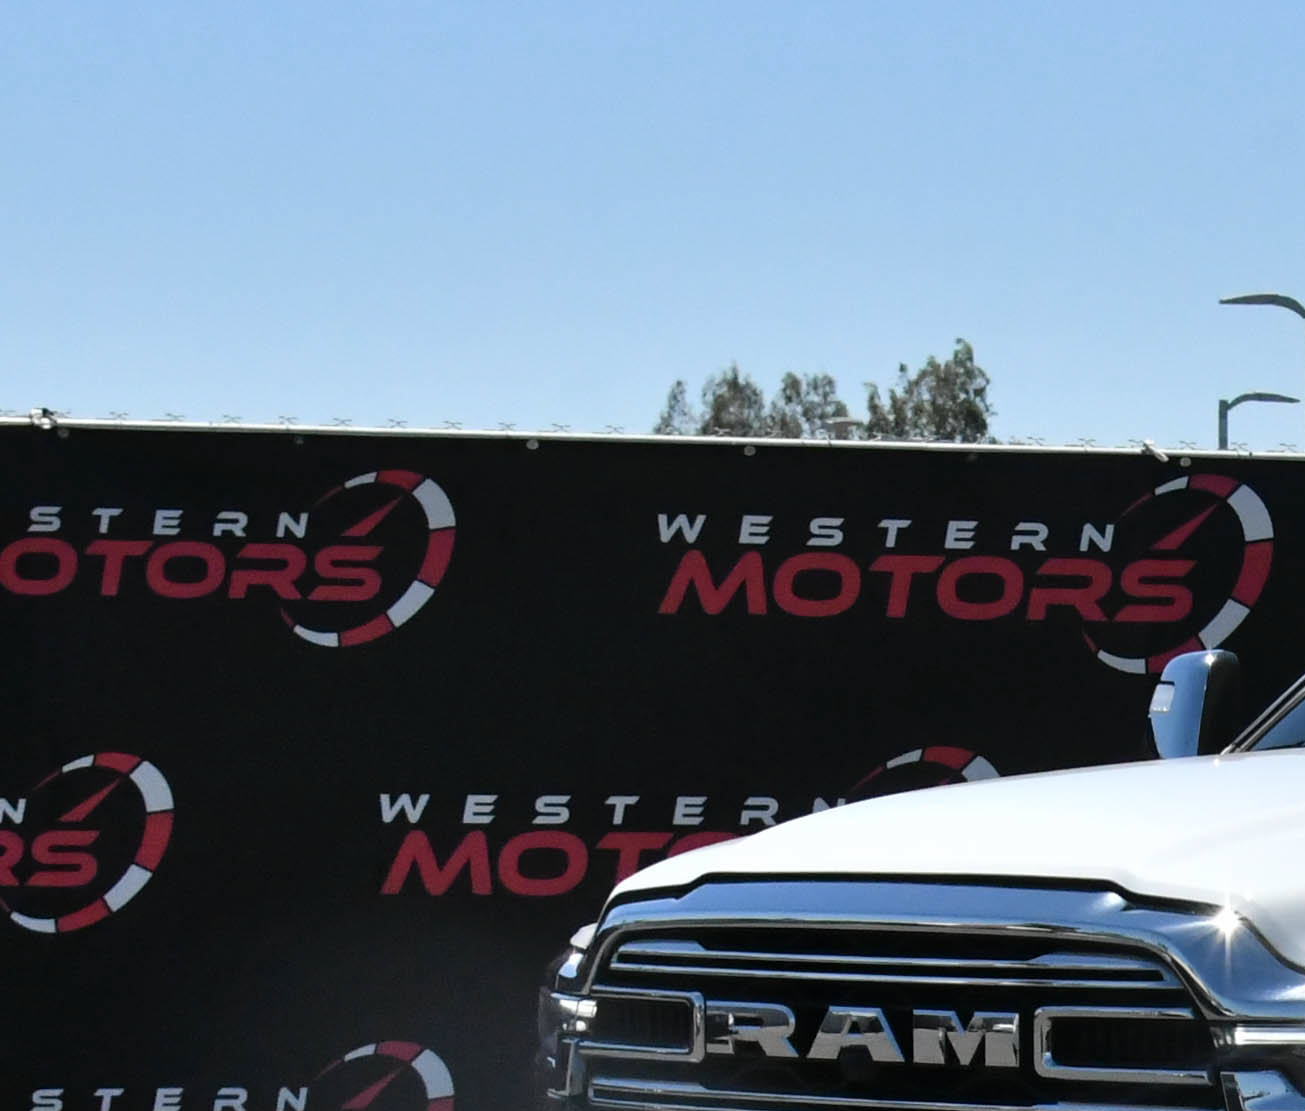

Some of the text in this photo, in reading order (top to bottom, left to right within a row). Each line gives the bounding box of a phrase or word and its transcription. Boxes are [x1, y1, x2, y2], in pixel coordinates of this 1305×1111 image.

[658, 514, 1115, 551] WESTERN
[659, 550, 1195, 621] MOTORS
[705, 1000, 1020, 1067] RAM
